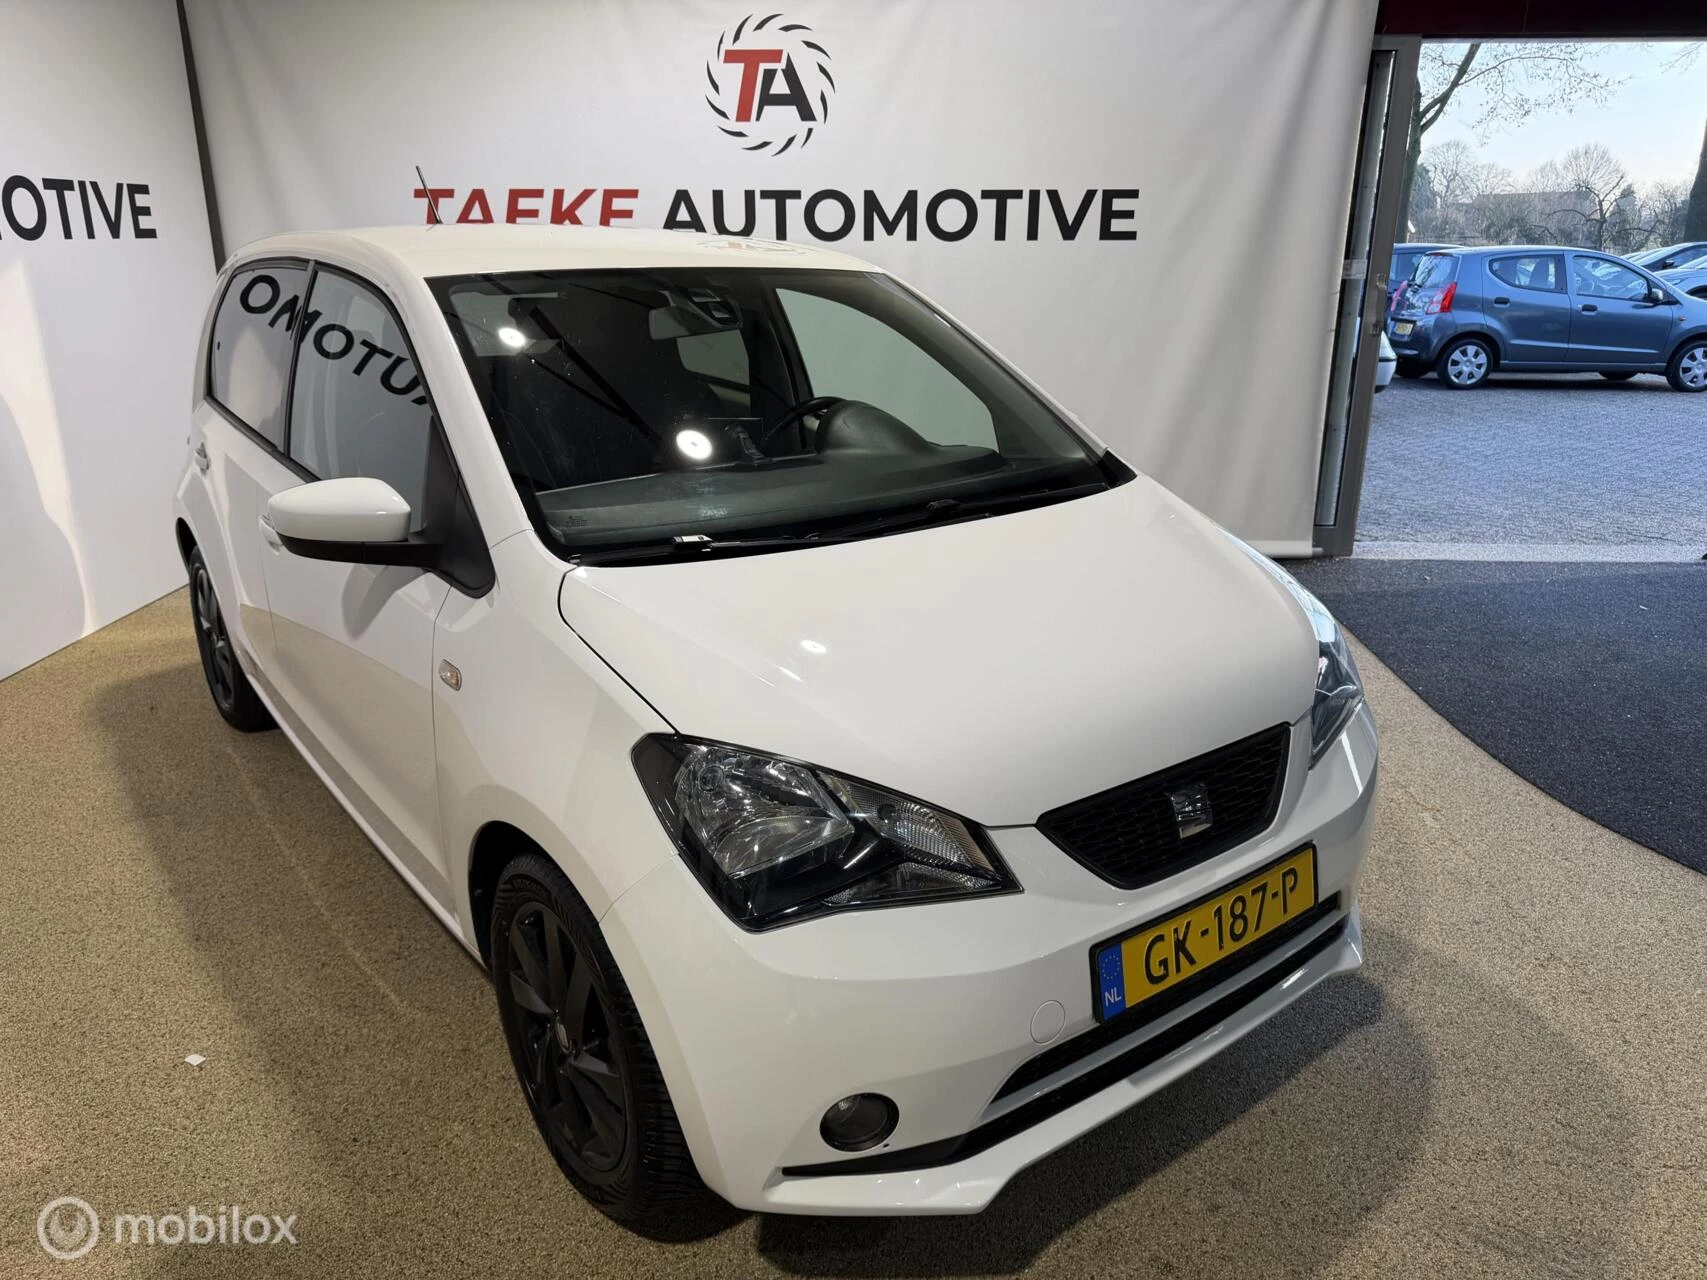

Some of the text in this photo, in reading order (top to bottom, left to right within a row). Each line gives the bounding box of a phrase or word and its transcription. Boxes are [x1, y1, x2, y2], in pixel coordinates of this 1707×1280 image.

[723, 49, 817, 123] TA
[0, 175, 157, 241] OTIVE
[663, 188, 1140, 242] AUTOMOTIVE
[1143, 866, 1298, 985] GK-187-P
[1104, 986, 1122, 1007] NL
